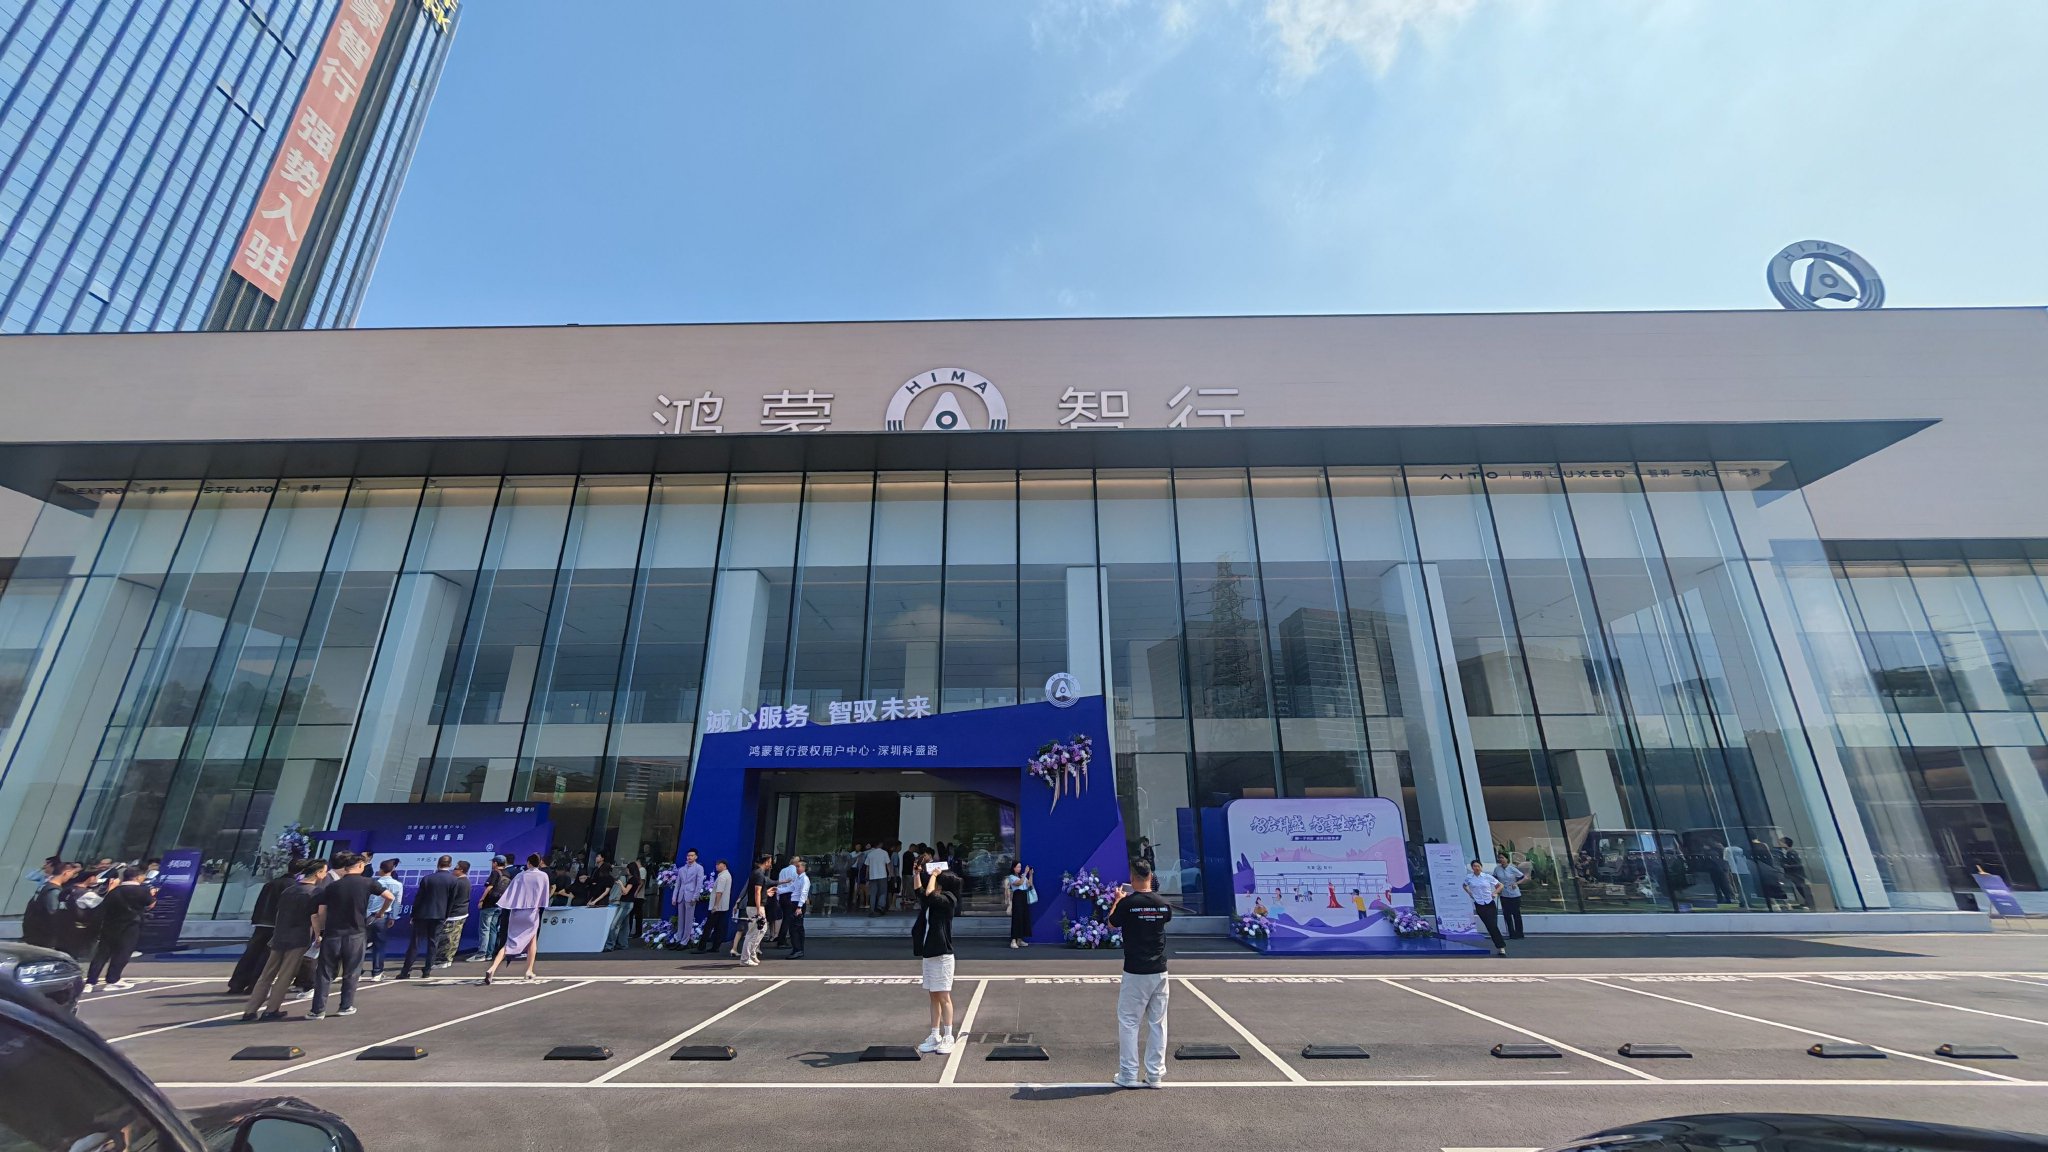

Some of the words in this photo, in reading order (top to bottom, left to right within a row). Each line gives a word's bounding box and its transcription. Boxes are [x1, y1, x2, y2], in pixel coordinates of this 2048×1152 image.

[244, 106, 337, 287] 强势入驻
[1782, 243, 1852, 262] HIMA
[905, 370, 988, 395] HIMA
[652, 389, 835, 434] 鸿蒙
[1058, 385, 1245, 429] 智行
[1549, 469, 1625, 478] LUXEED
[1681, 469, 1718, 477] SAIC
[203, 485, 274, 494] STELATO
[705, 703, 810, 734] 诚心服务
[828, 695, 931, 725] 智驭未来
[748, 744, 939, 757] 鸿蒙智行授权用户中心·深圳科盛路
[1309, 812, 1376, 837] 智享生活节
